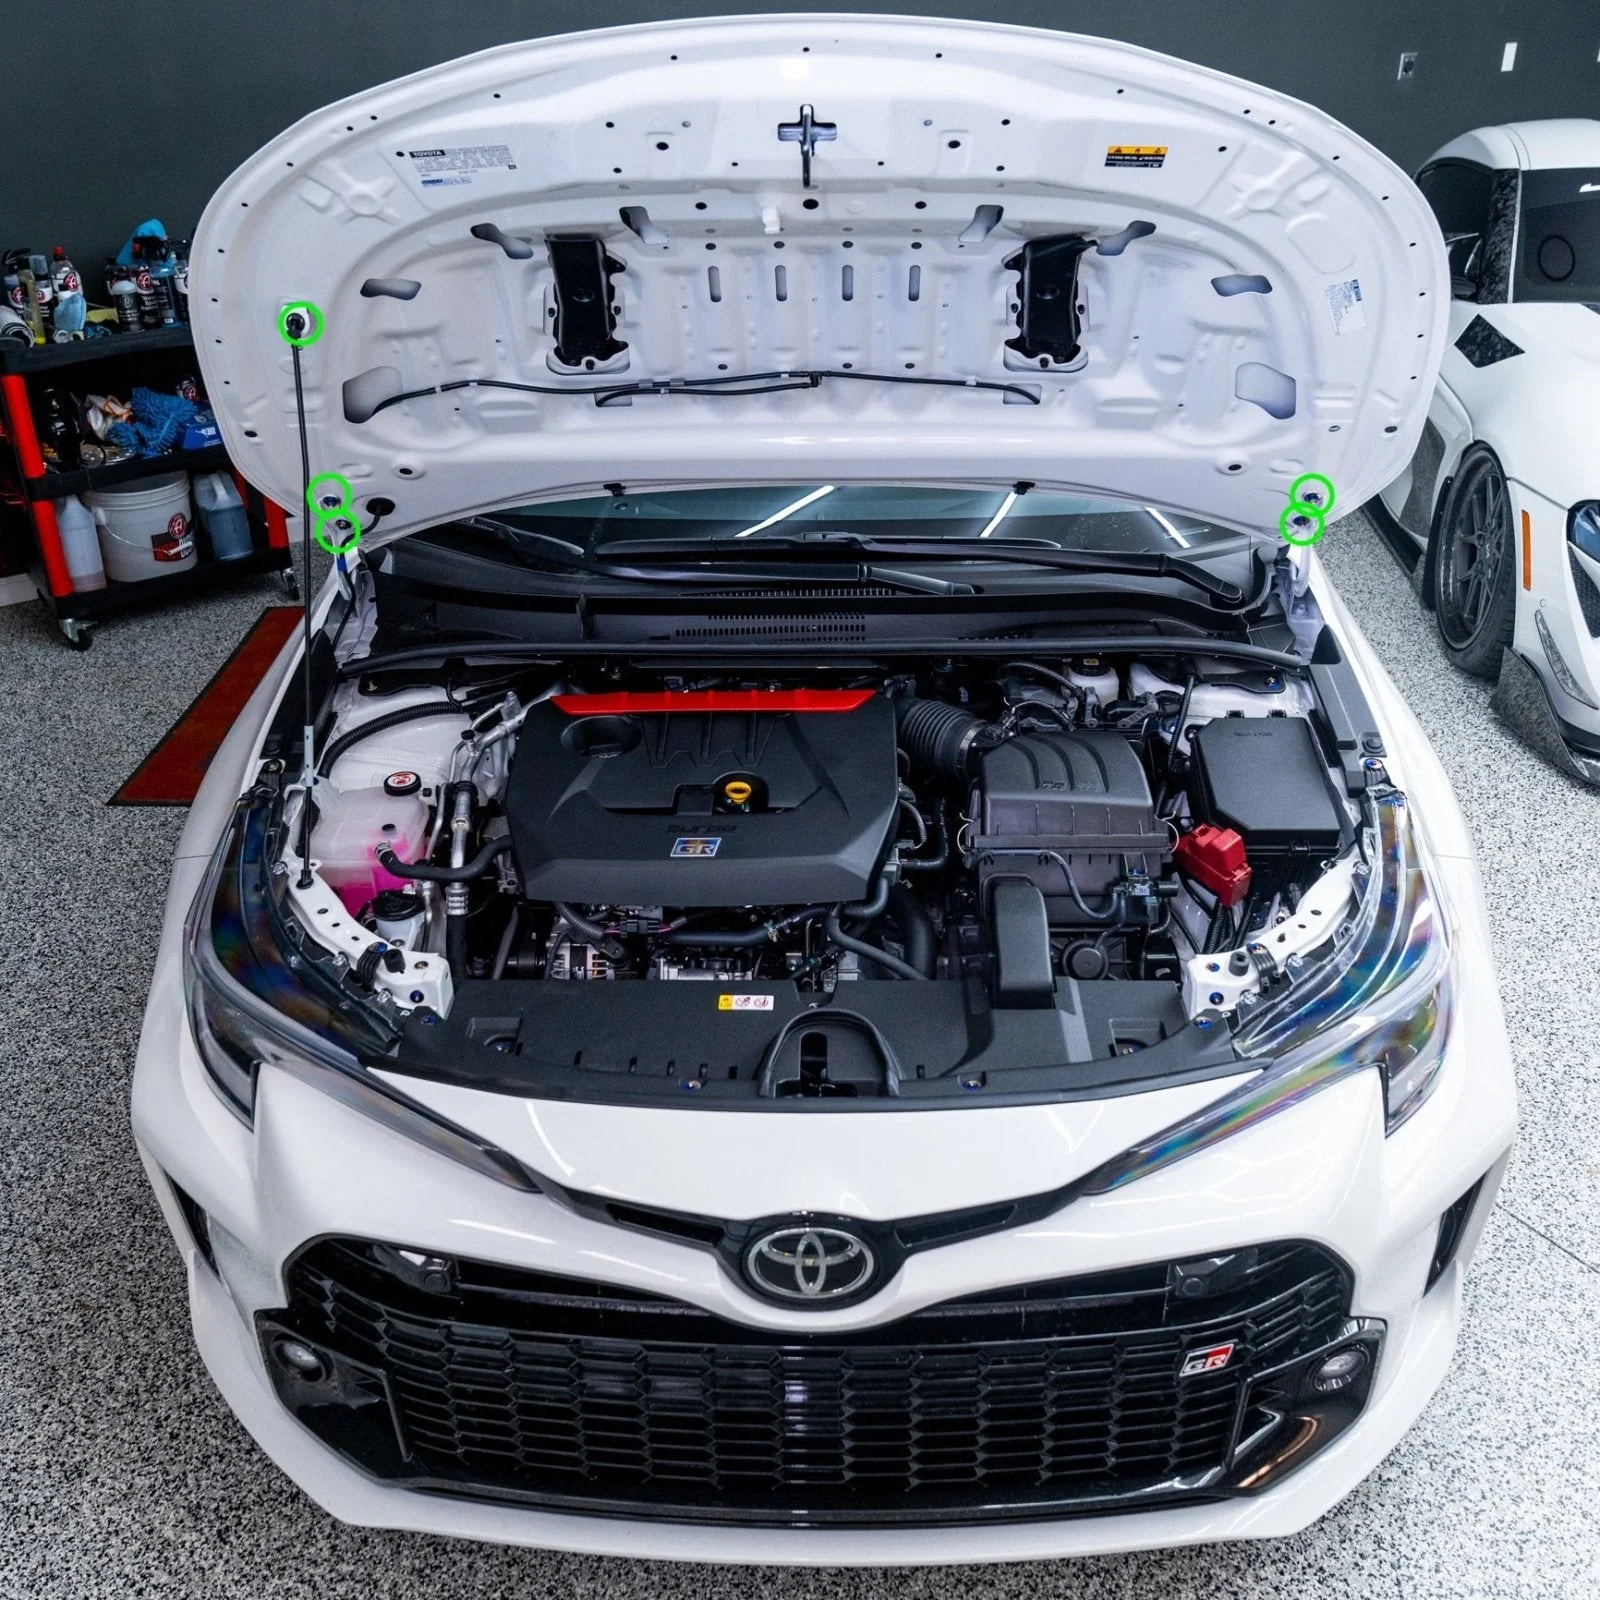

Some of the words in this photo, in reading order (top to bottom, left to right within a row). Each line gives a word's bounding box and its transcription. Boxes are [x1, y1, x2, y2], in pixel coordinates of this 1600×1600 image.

[412, 150, 443, 158] TOYOTA
[675, 843, 716, 855] GR
[1183, 1353, 1228, 1373] GR
